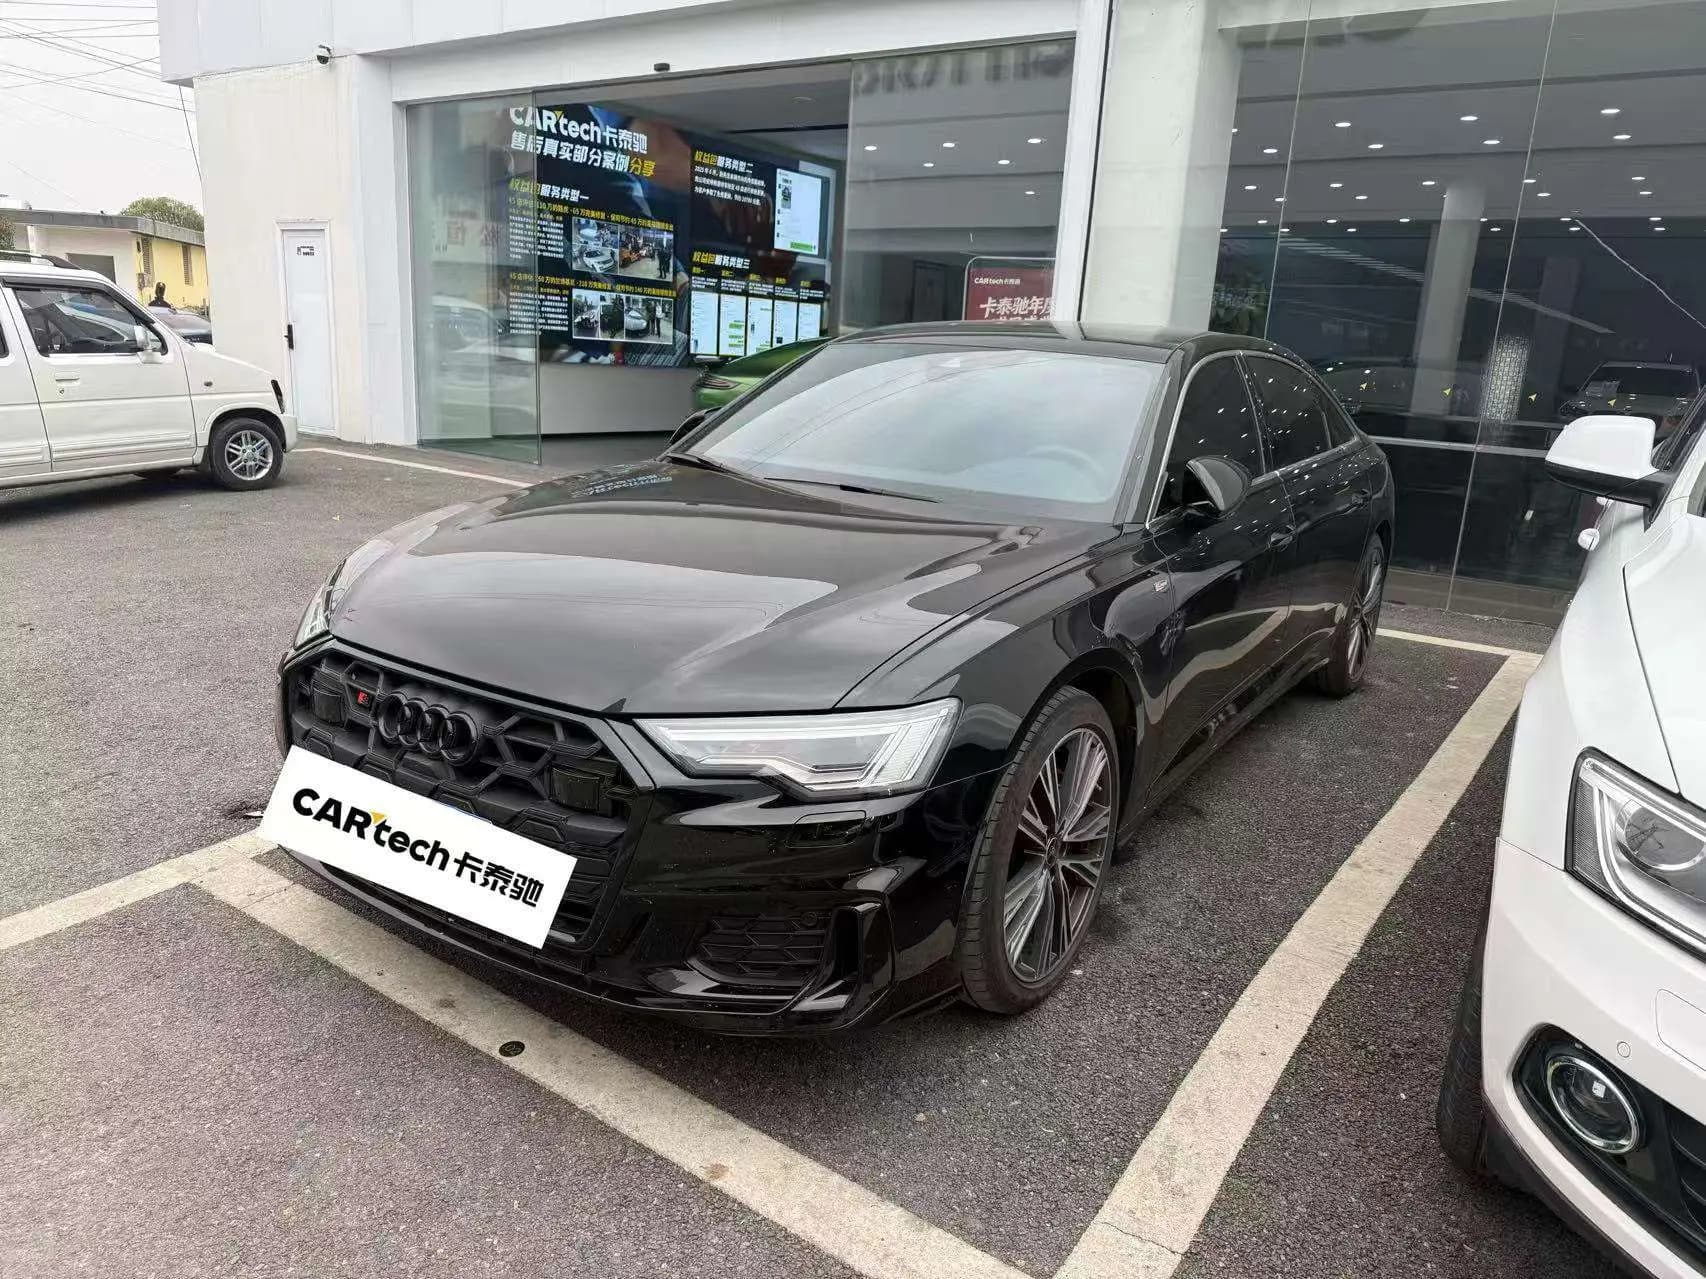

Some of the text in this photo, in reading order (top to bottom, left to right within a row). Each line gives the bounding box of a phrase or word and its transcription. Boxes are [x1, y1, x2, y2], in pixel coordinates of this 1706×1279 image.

[509, 106, 648, 154] CARtech 卡泰驰
[510, 130, 656, 177] 售后真实部分案例分享
